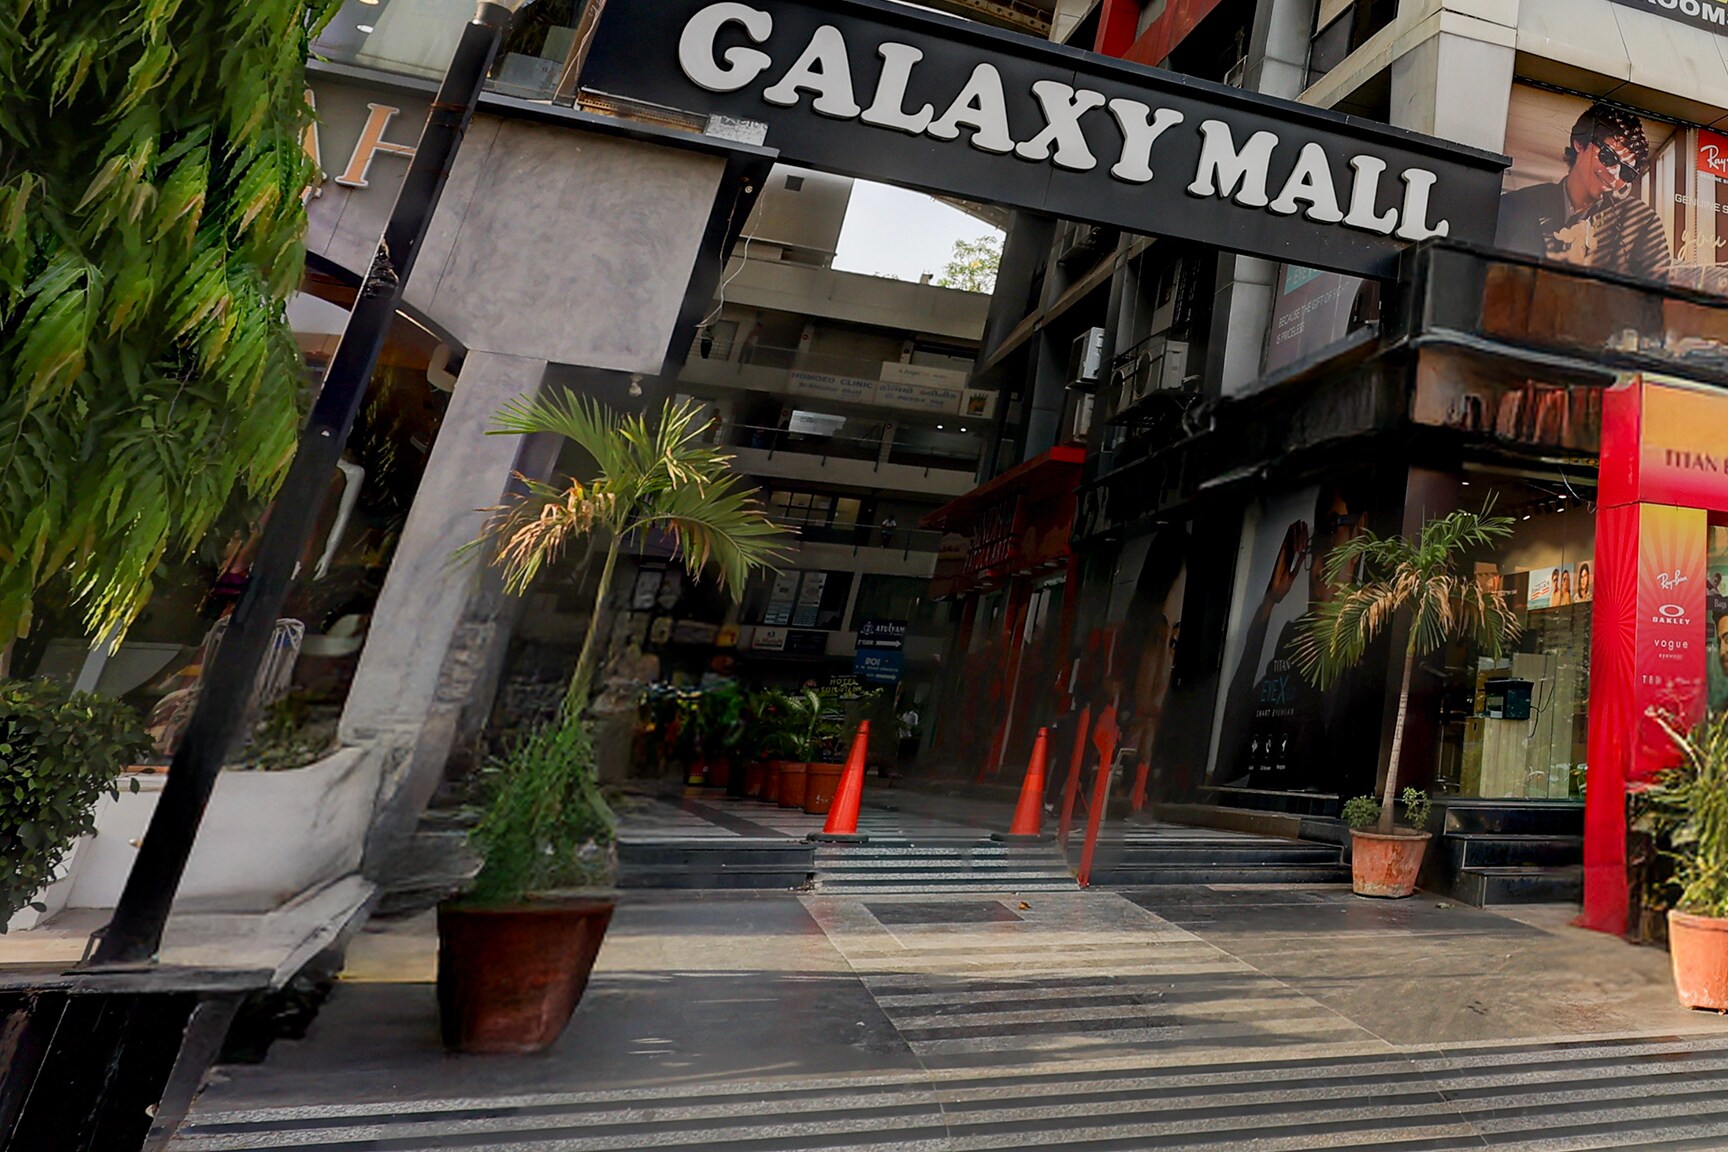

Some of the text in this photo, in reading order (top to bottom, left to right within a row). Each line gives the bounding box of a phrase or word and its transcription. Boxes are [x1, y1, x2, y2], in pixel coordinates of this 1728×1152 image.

[678, 1, 1450, 242] GALAXY MALL
[1675, 193, 1720, 212] GENUINE
[840, 379, 874, 390] CLINIC
[1665, 449, 1717, 472] TITAN
[1652, 616, 1691, 625] OAKLEY
[1654, 639, 1689, 651] vogue
[1273, 658, 1291, 673] TITAN
